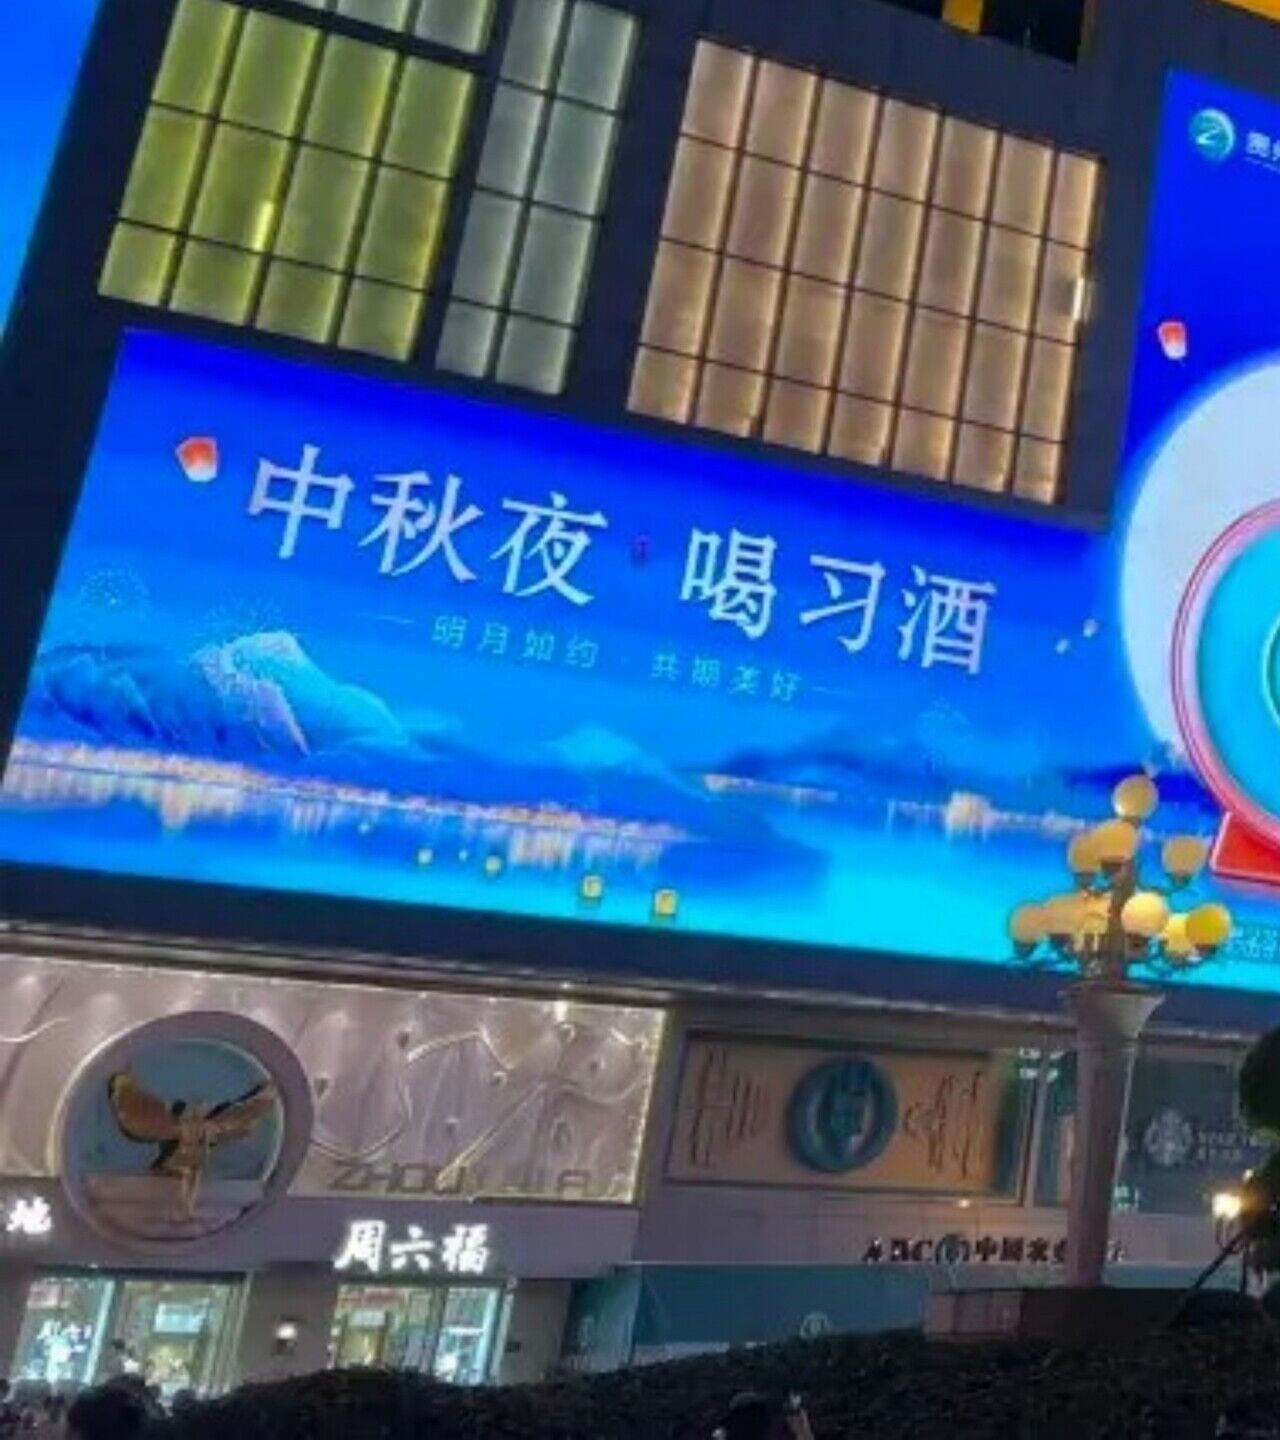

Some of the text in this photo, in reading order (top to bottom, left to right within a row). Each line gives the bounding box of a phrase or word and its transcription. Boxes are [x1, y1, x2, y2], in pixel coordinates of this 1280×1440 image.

[245, 443, 998, 675] 中秋夜 喝习酒
[431, 614, 600, 670] 明月如约
[332, 1218, 490, 1274] 周六福
